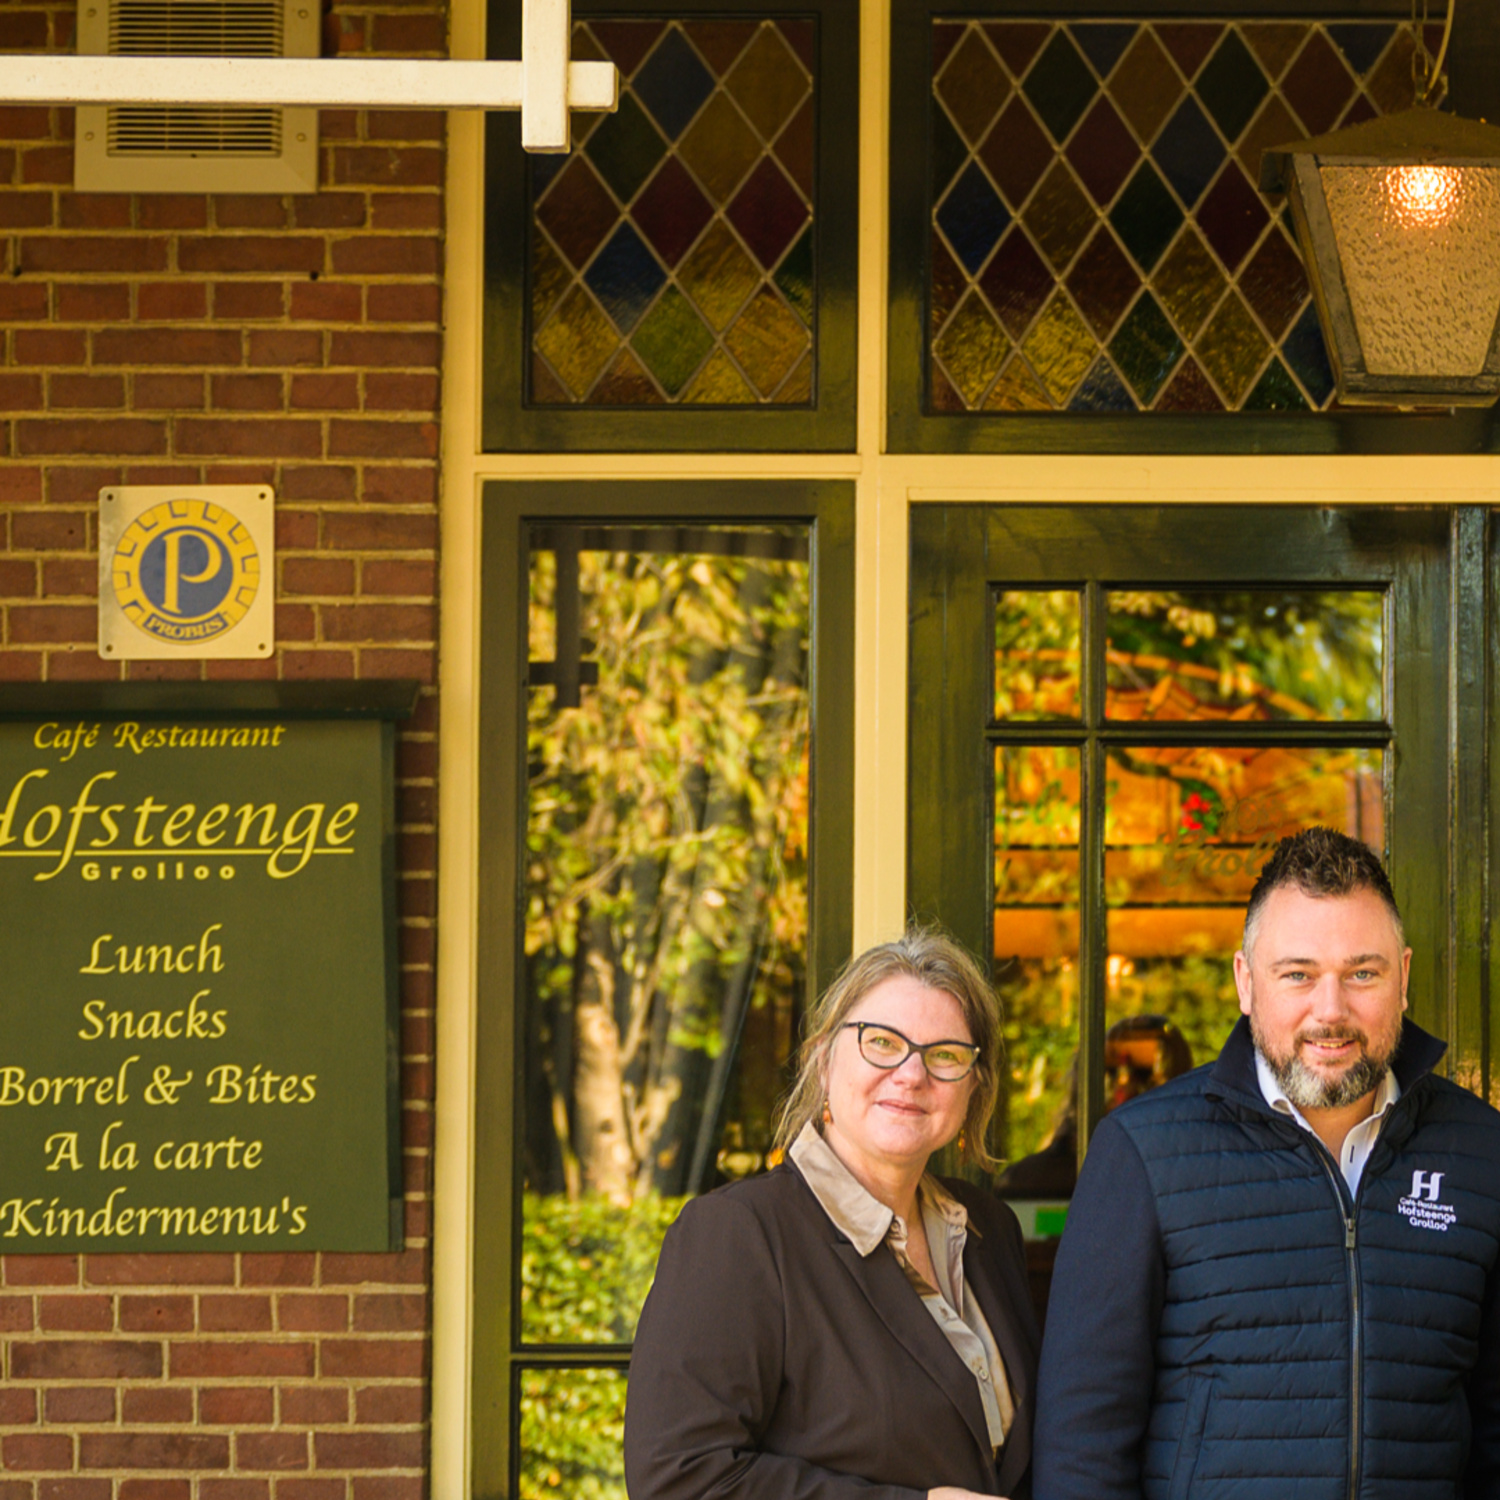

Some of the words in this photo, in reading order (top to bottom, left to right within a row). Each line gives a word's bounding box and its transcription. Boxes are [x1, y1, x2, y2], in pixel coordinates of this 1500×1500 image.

[161, 529, 222, 614] P
[146, 614, 225, 639] PROBUS
[33, 721, 100, 762] Café
[113, 721, 287, 755] Restaurant
[81, 862, 236, 881] Grolloo
[1156, 829, 1276, 887] Grol
[79, 923, 226, 974] Lunch
[78, 989, 228, 1040] Snacks
[0, 1055, 141, 1106] Borrel
[143, 1064, 193, 1105] &
[206, 1063, 318, 1104] Bites
[44, 1131, 84, 1172] A
[98, 1121, 140, 1171] la
[153, 1135, 263, 1171] carte
[1407, 1169, 1445, 1201] H
[0, 1186, 309, 1238] Kindermenu's
[1398, 1204, 1456, 1223] Hofsteenge
[1409, 1216, 1447, 1231] Grolloo
